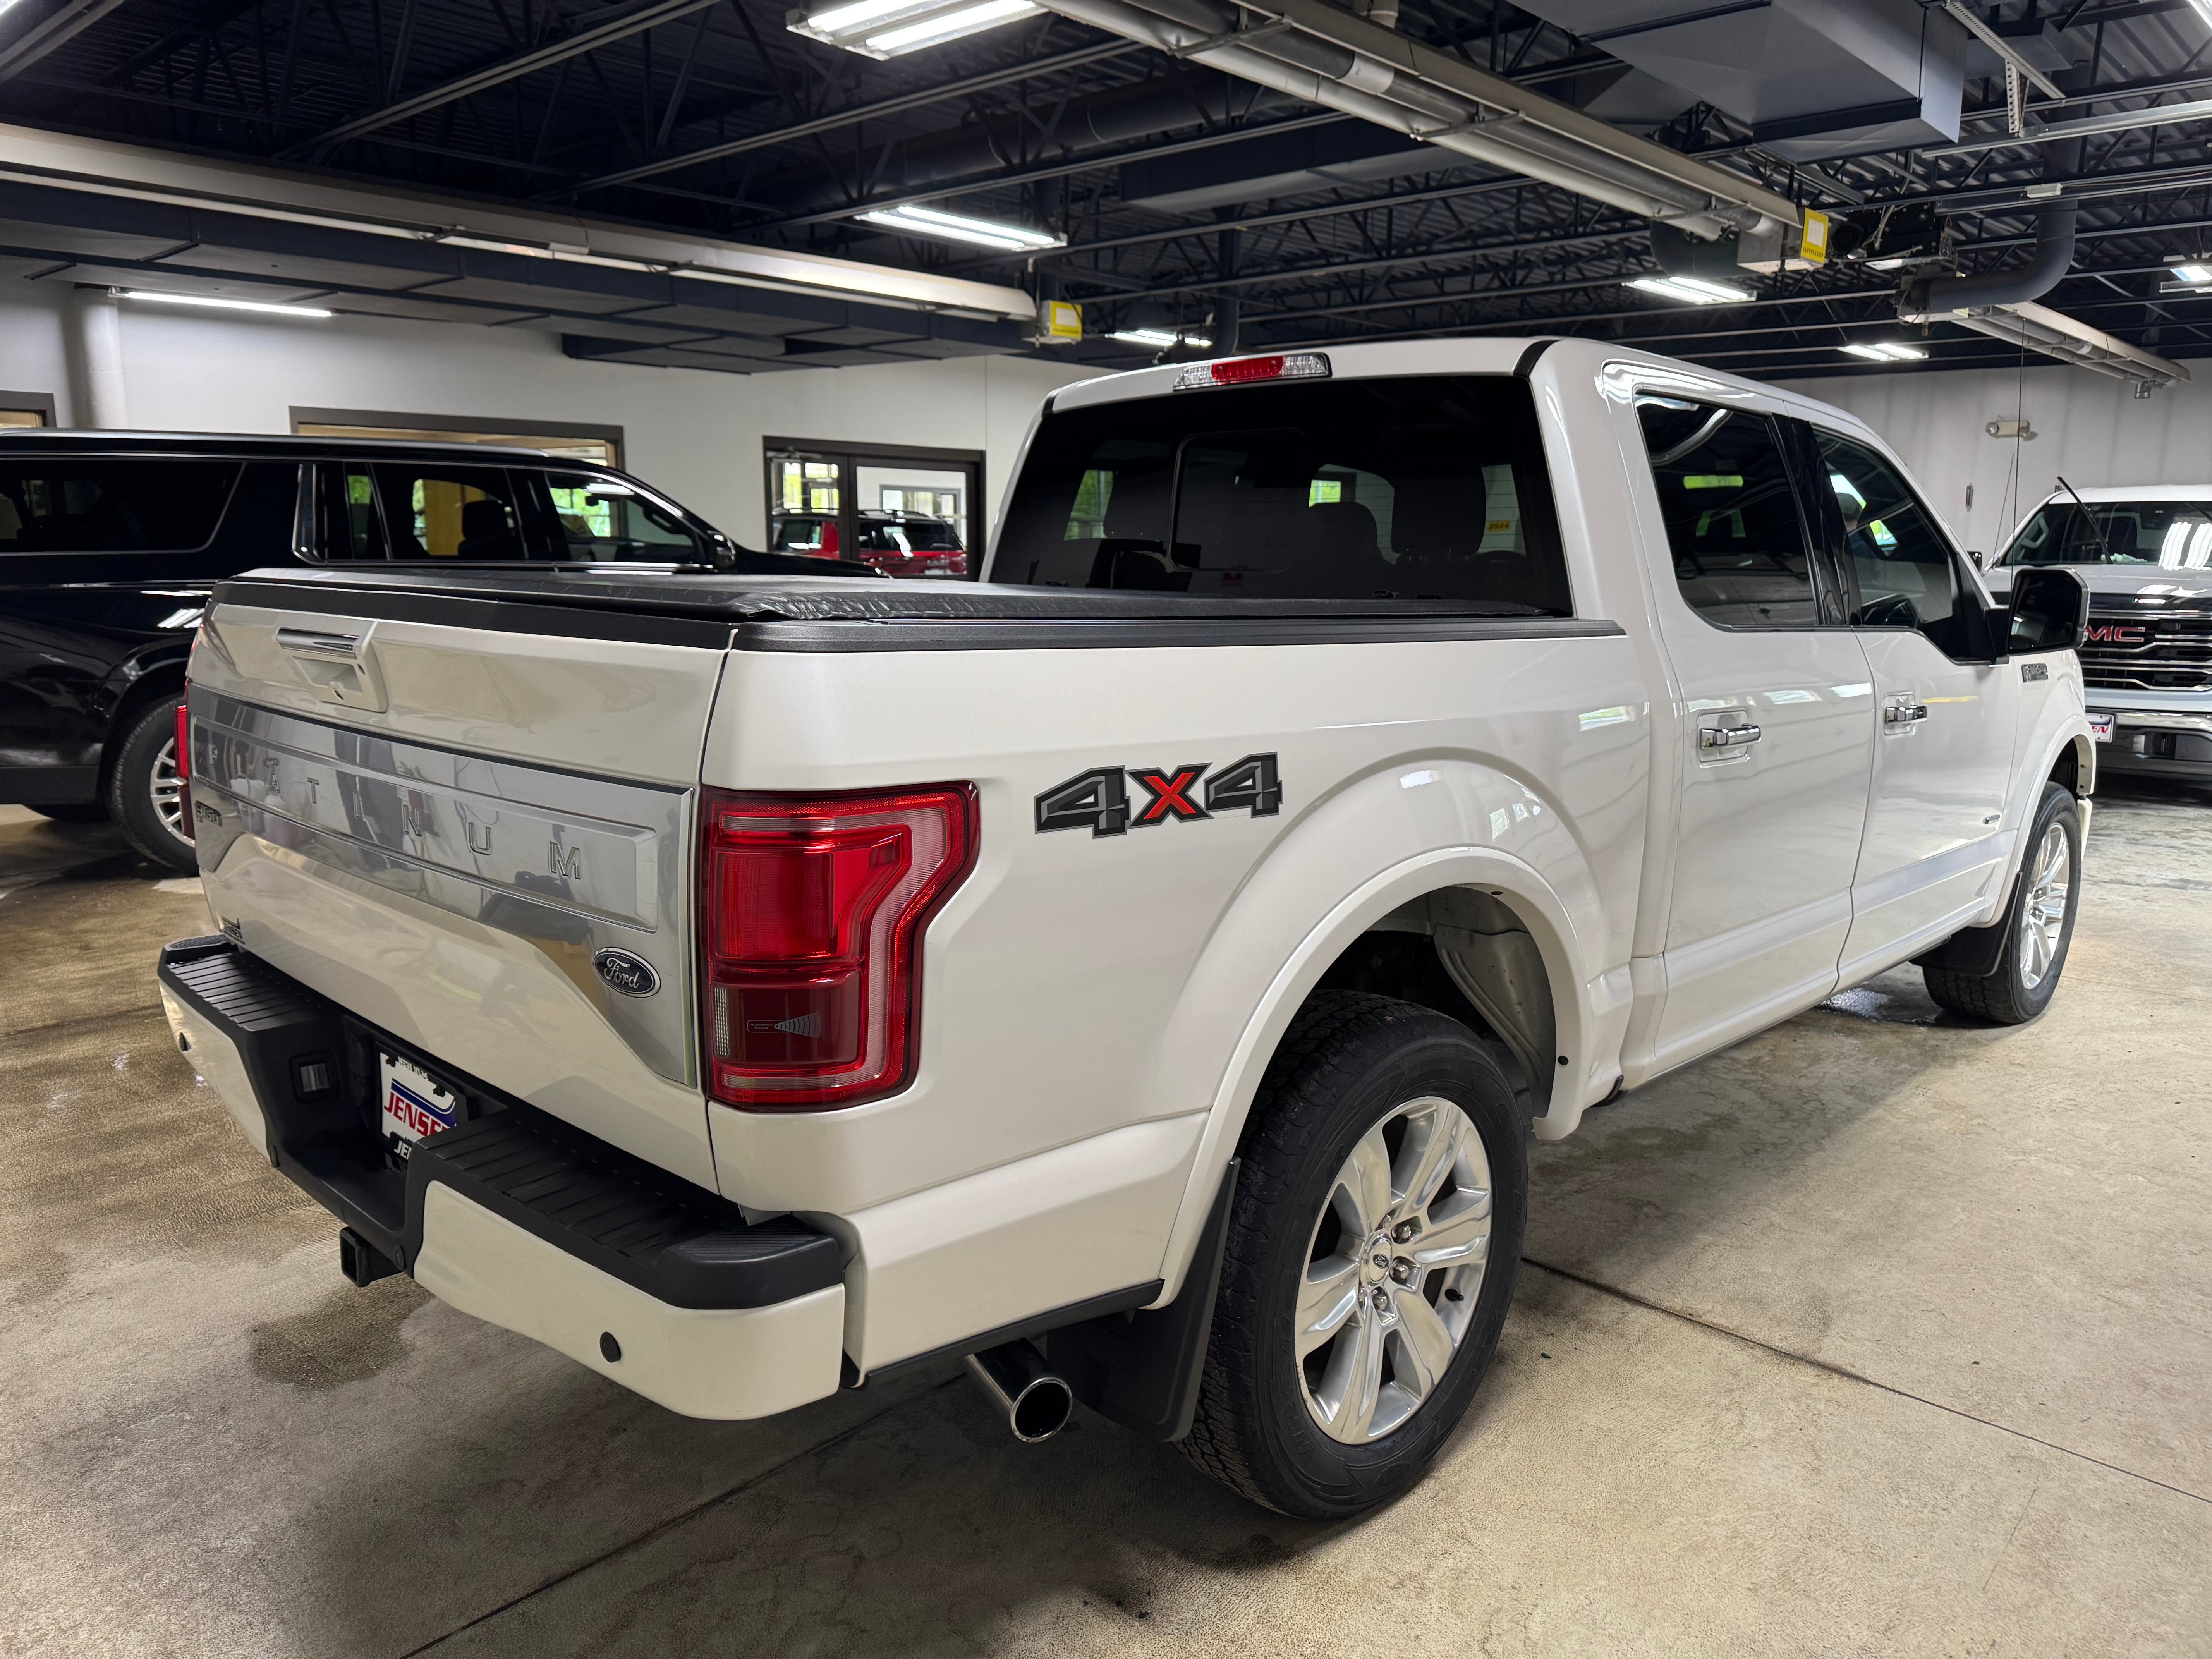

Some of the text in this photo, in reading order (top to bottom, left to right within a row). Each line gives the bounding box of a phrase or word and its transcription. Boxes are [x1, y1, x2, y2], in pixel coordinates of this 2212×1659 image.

[2086, 625, 2145, 642] MC
[208, 744, 581, 880] PLATINUM
[604, 958, 639, 988] Ford
[1375, 1255, 1387, 1267] Ford
